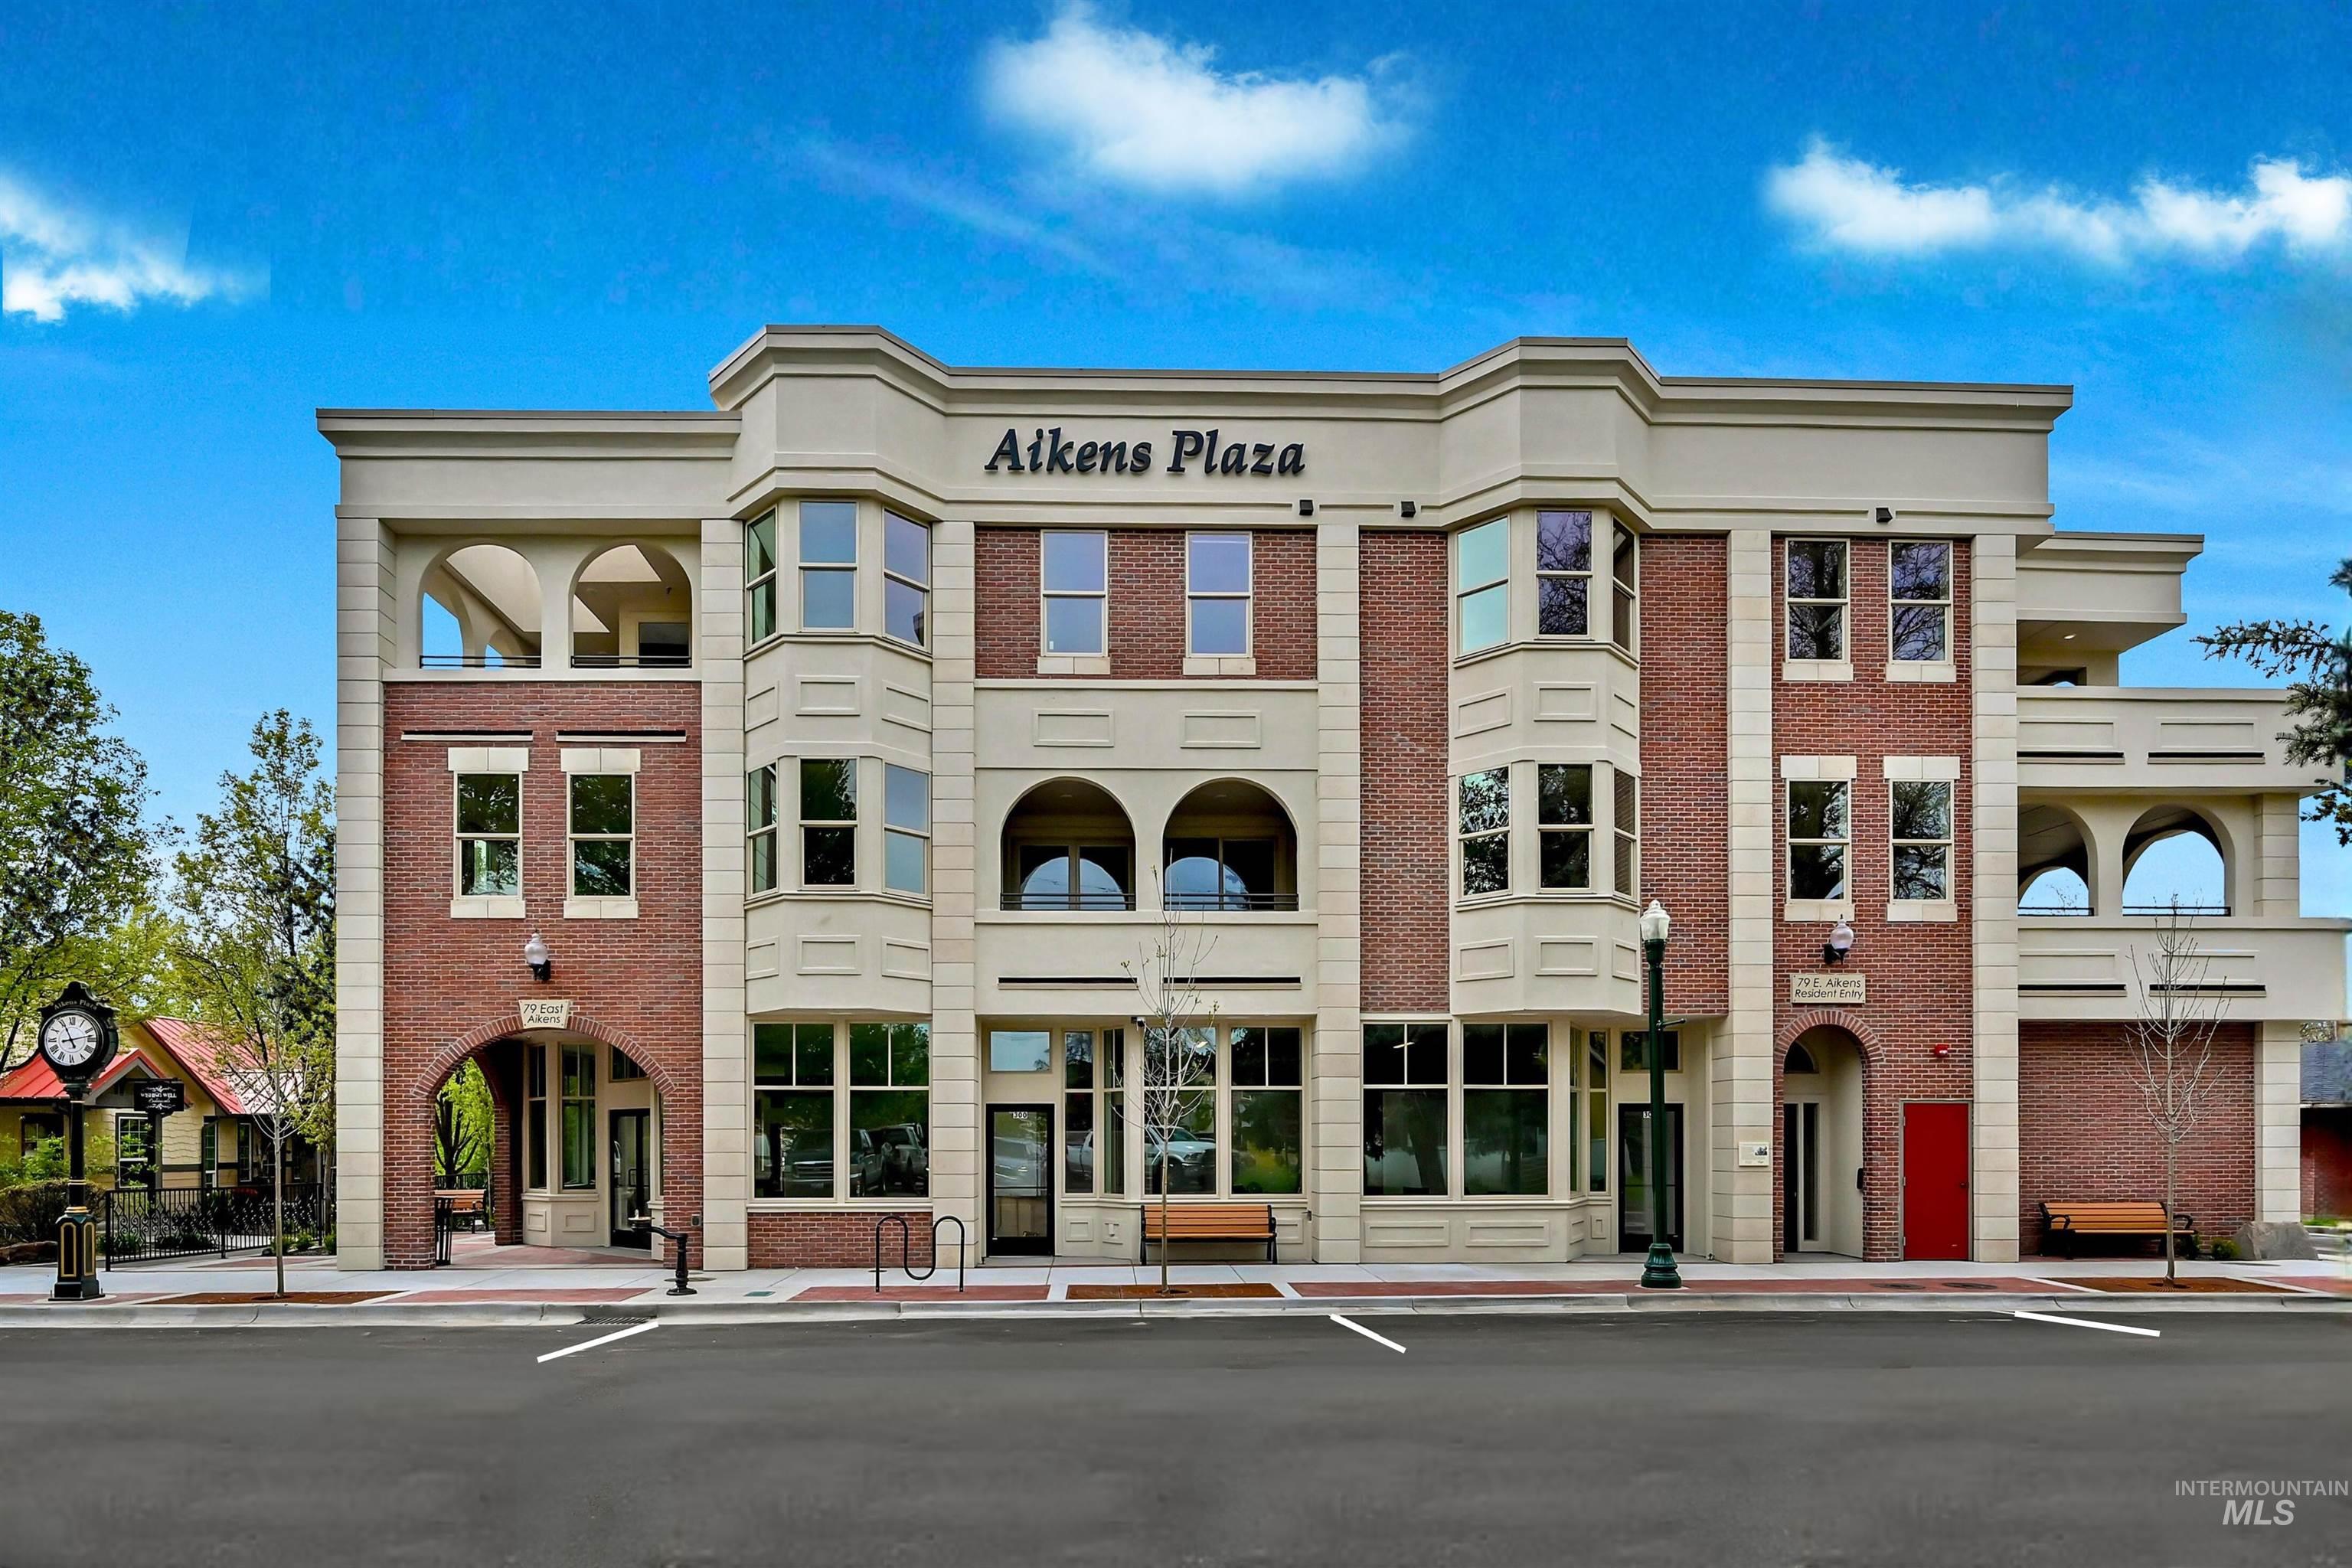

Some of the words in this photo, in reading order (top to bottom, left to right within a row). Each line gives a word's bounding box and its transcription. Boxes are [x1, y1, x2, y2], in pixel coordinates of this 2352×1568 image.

[984, 426, 1152, 474] Aikens
[1166, 429, 1305, 474] Plaza
[1797, 978, 1811, 988] 79
[1813, 978, 1822, 988] E.
[1825, 977, 1861, 988] Aikens
[1795, 988, 1837, 998] Resident
[1839, 988, 1864, 999] Entry
[523, 1004, 537, 1014] 79
[540, 1003, 564, 1014] East
[527, 1014, 561, 1024] Aikens
